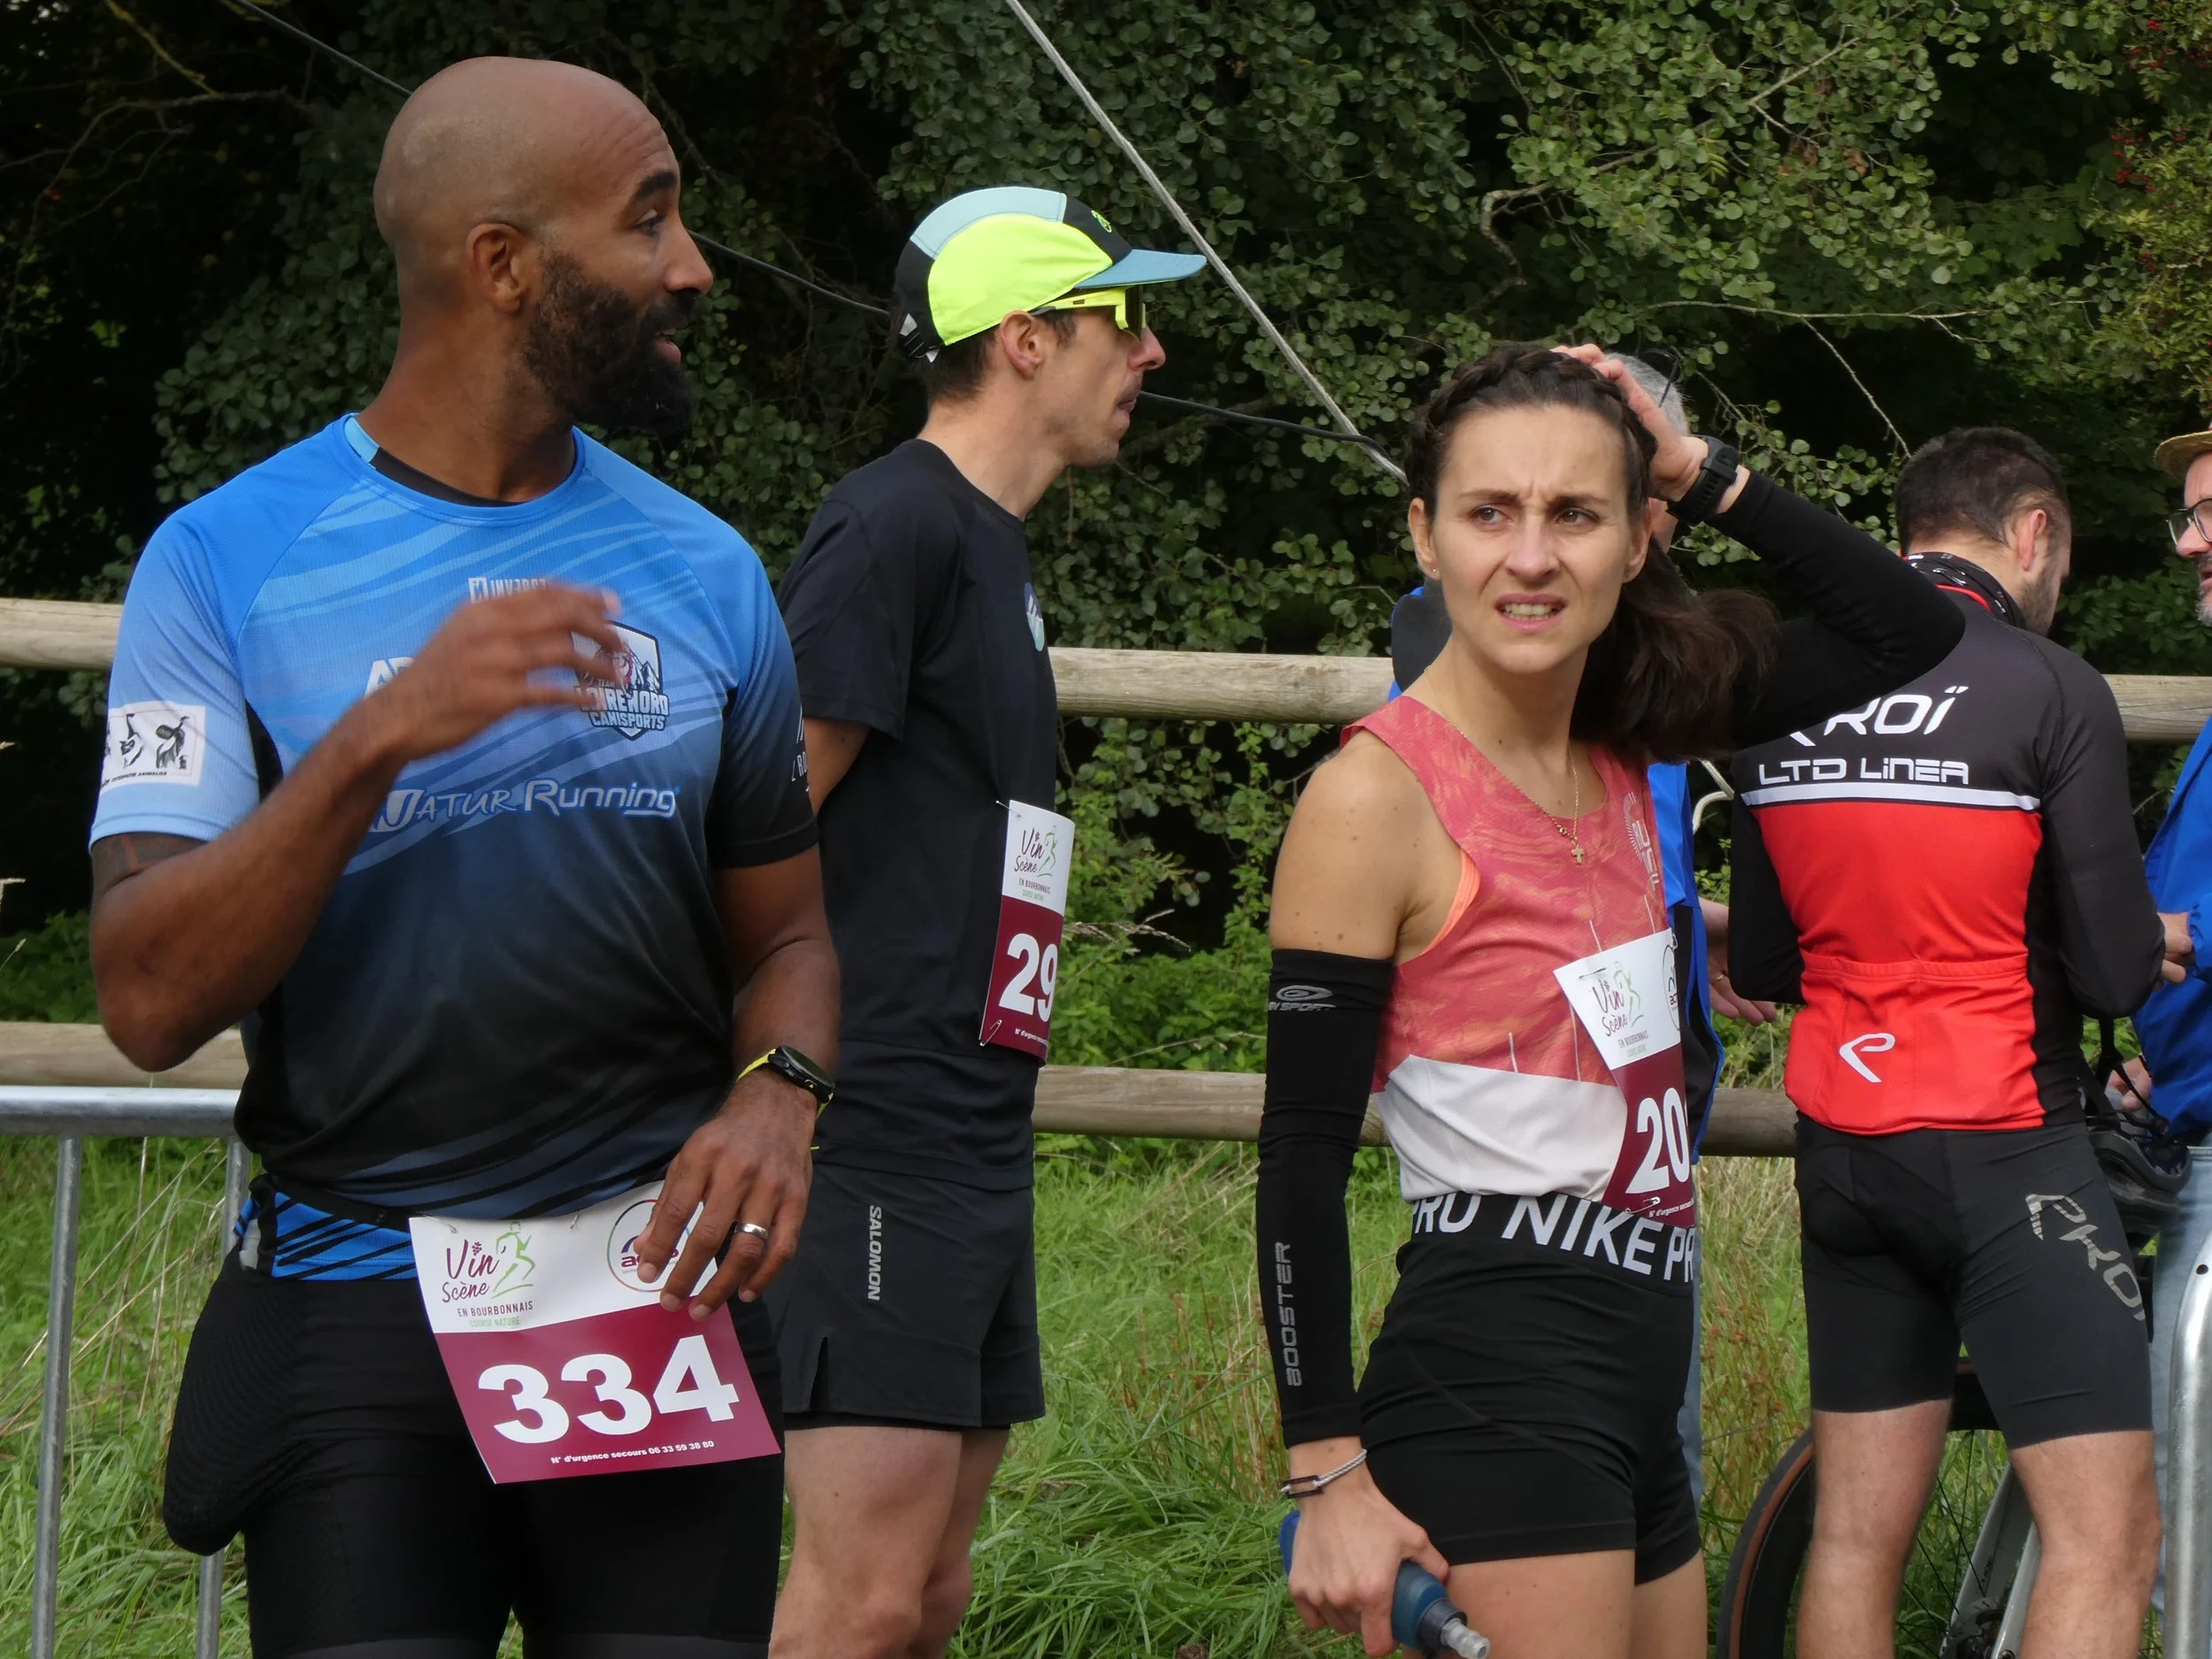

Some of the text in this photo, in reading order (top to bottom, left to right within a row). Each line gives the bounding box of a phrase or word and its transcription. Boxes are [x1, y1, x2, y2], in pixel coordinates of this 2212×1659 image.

[626, 690, 669, 716] NORD
[589, 711, 665, 730] CANISPORTS
[1759, 758, 1847, 786] LTD
[525, 780, 677, 818] Running
[999, 933, 1058, 1023] 29
[1501, 1194, 1664, 1276] NIKE
[868, 1205, 882, 1301] SALOMON
[442, 1280, 490, 1303] Scène
[457, 1301, 534, 1317] EN BOURBONNAIS
[1275, 1241, 1302, 1386] BOOSTER
[478, 1334, 740, 1444] 334
[564, 1452, 609, 1463] d'urgence
[611, 1448, 648, 1458] secours
[675, 1443, 687, 1452] 59
[688, 1441, 701, 1450] 38
[703, 1440, 715, 1448] 80
